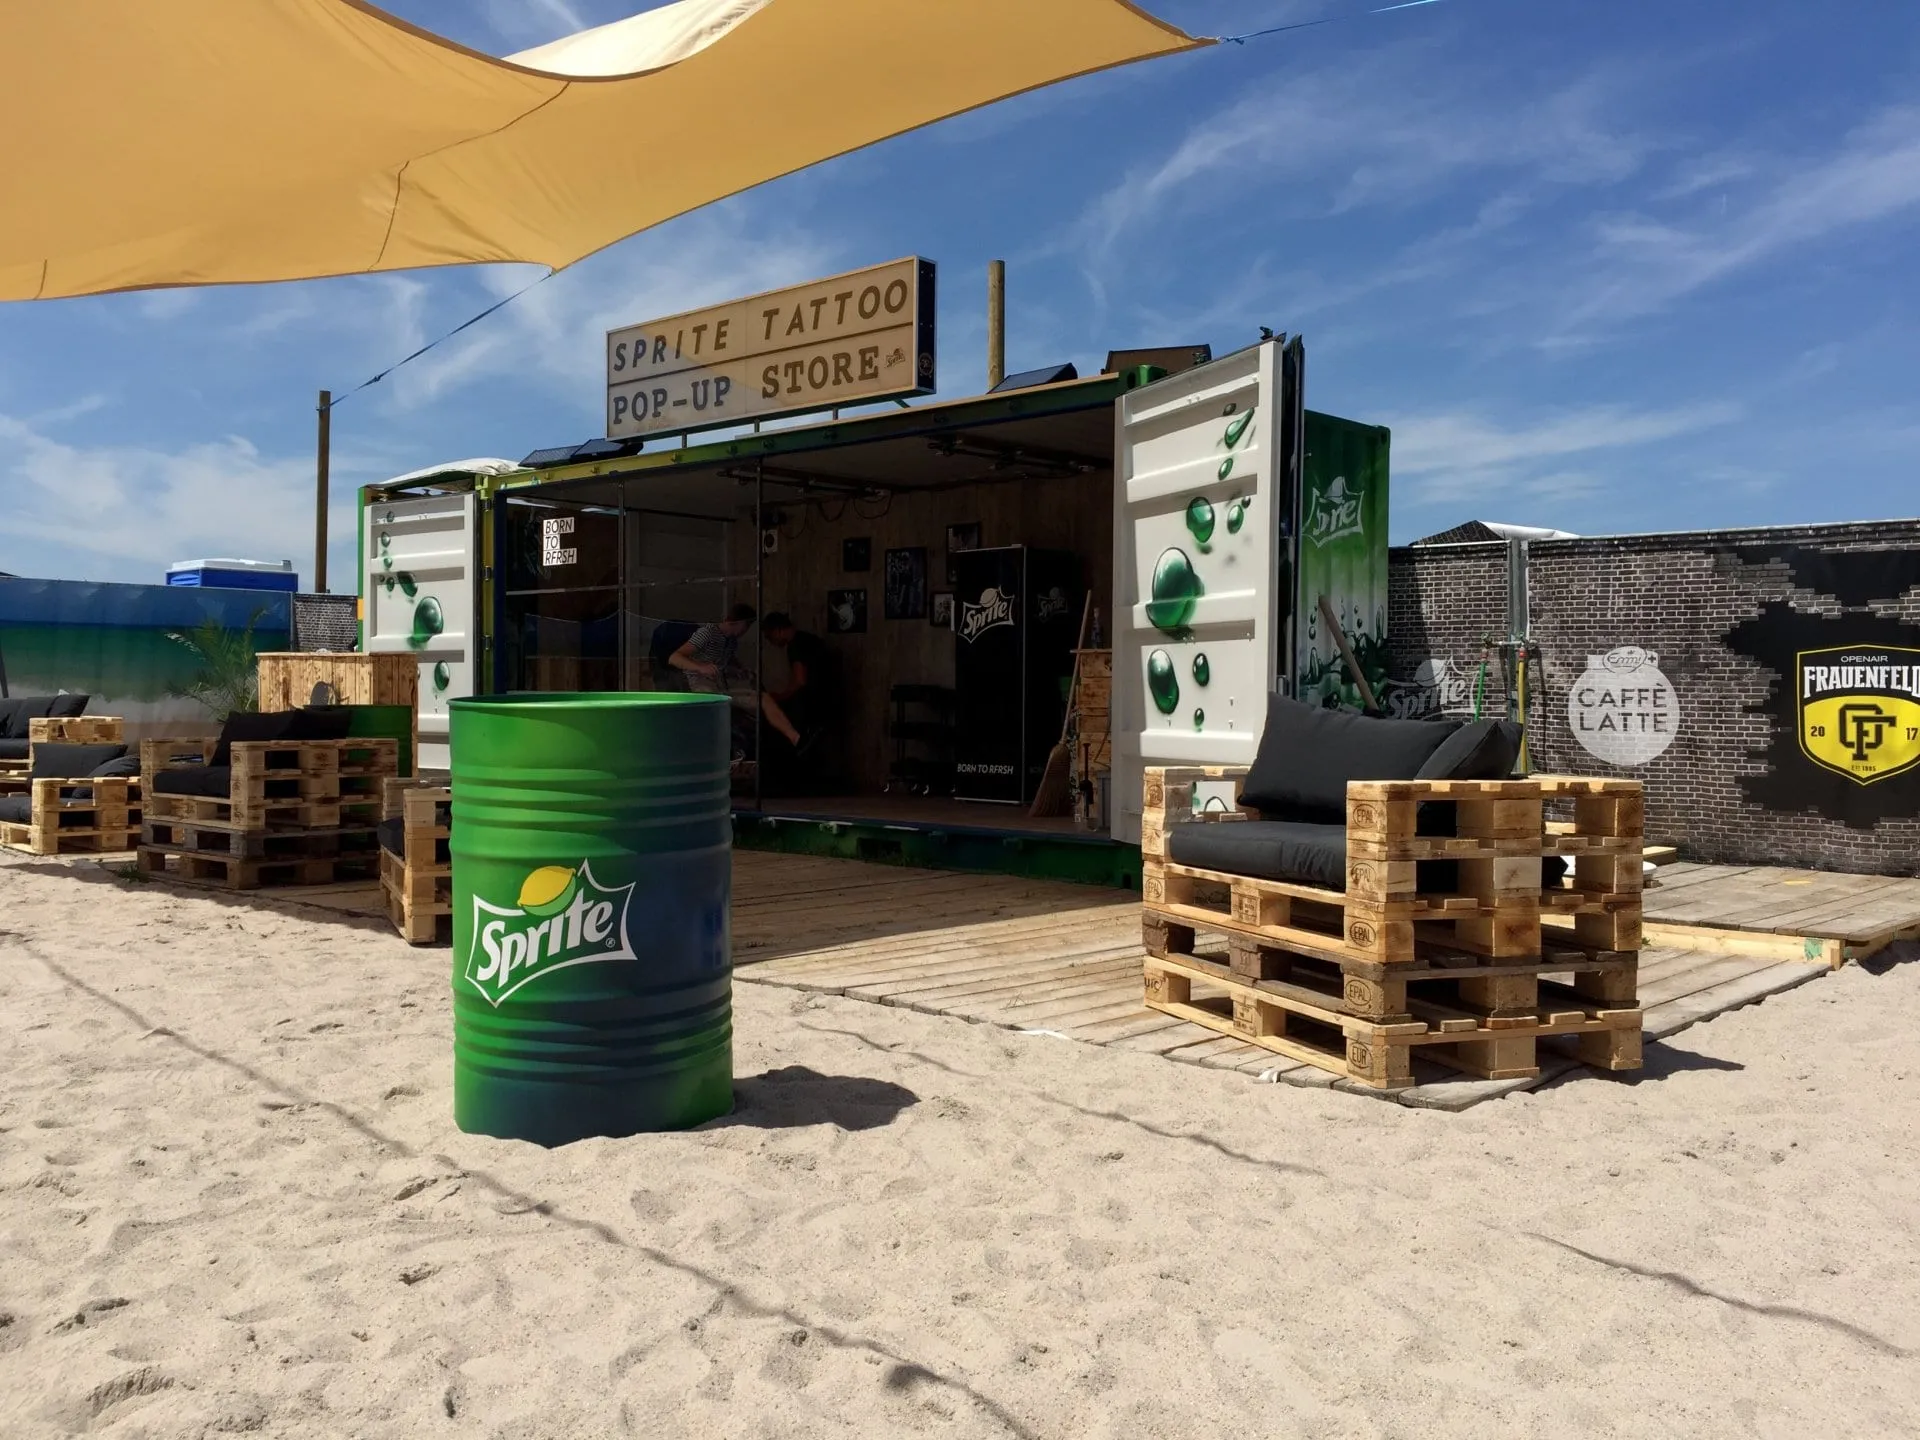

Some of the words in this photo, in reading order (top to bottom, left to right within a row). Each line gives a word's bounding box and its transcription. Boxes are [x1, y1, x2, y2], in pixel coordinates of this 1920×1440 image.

[613, 319, 730, 371] SPRITE
[762, 279, 908, 340] TATTOO
[613, 376, 731, 425] POP-UP
[762, 345, 879, 399] STORE
[545, 519, 573, 534] BORN
[545, 535, 559, 549] TO
[545, 550, 575, 565] RFRSH
[963, 598, 1009, 637] Sprite
[1840, 655, 1889, 663] OPENAIR
[1388, 671, 1467, 719] Sprite
[1577, 683, 1668, 709] CAFFÈ
[1579, 712, 1668, 732] LATTE
[1810, 725, 1825, 737] 20
[1905, 727, 1919, 740] 17
[957, 763, 977, 773] BORN
[978, 764, 989, 774] TO
[476, 887, 614, 989] Sprite
[1353, 926, 1373, 944] EPAL
[1349, 985, 1368, 1002] EPAL
